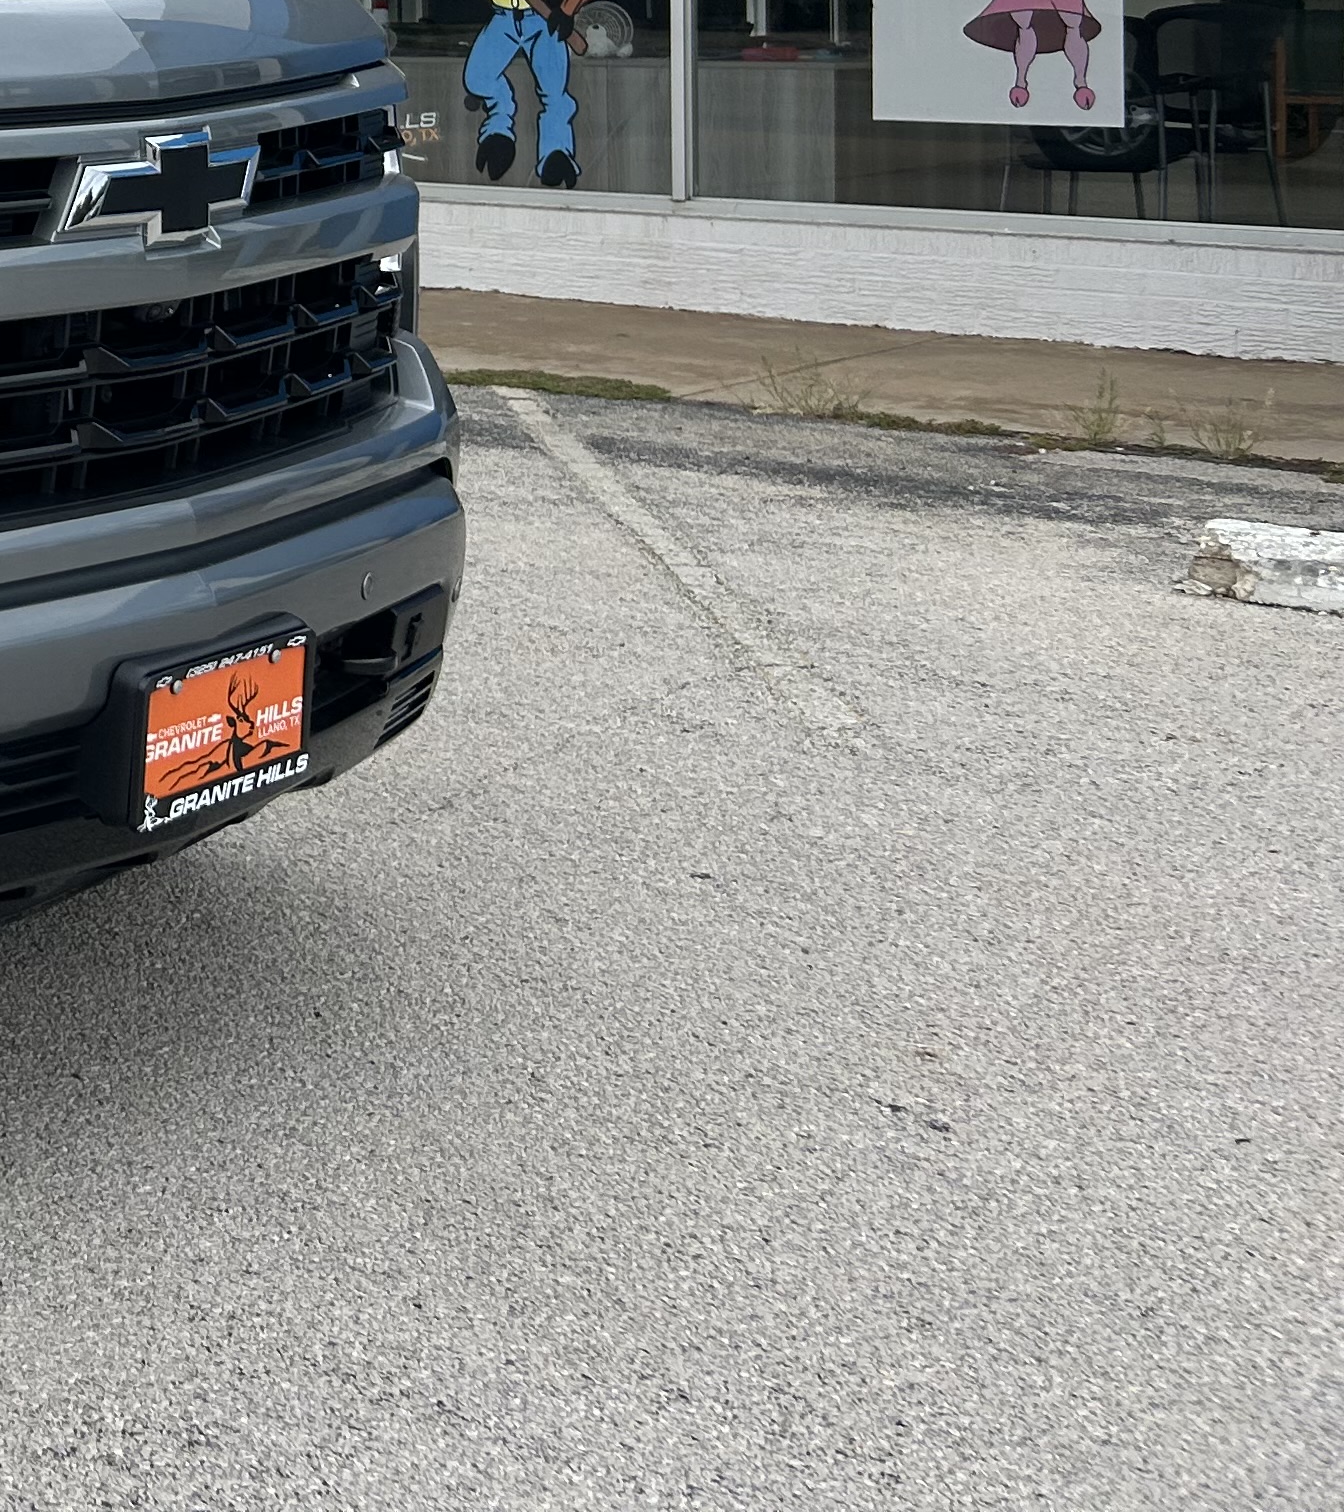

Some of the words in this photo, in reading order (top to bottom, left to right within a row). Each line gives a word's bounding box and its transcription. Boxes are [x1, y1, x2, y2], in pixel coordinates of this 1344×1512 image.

[145, 722, 224, 763] GRANITE
[256, 695, 303, 727] HILLS
[158, 715, 208, 740] CHEVROLET
[290, 713, 301, 727] TX
[169, 772, 256, 819] GRANITE
[256, 753, 310, 788] HILLS
